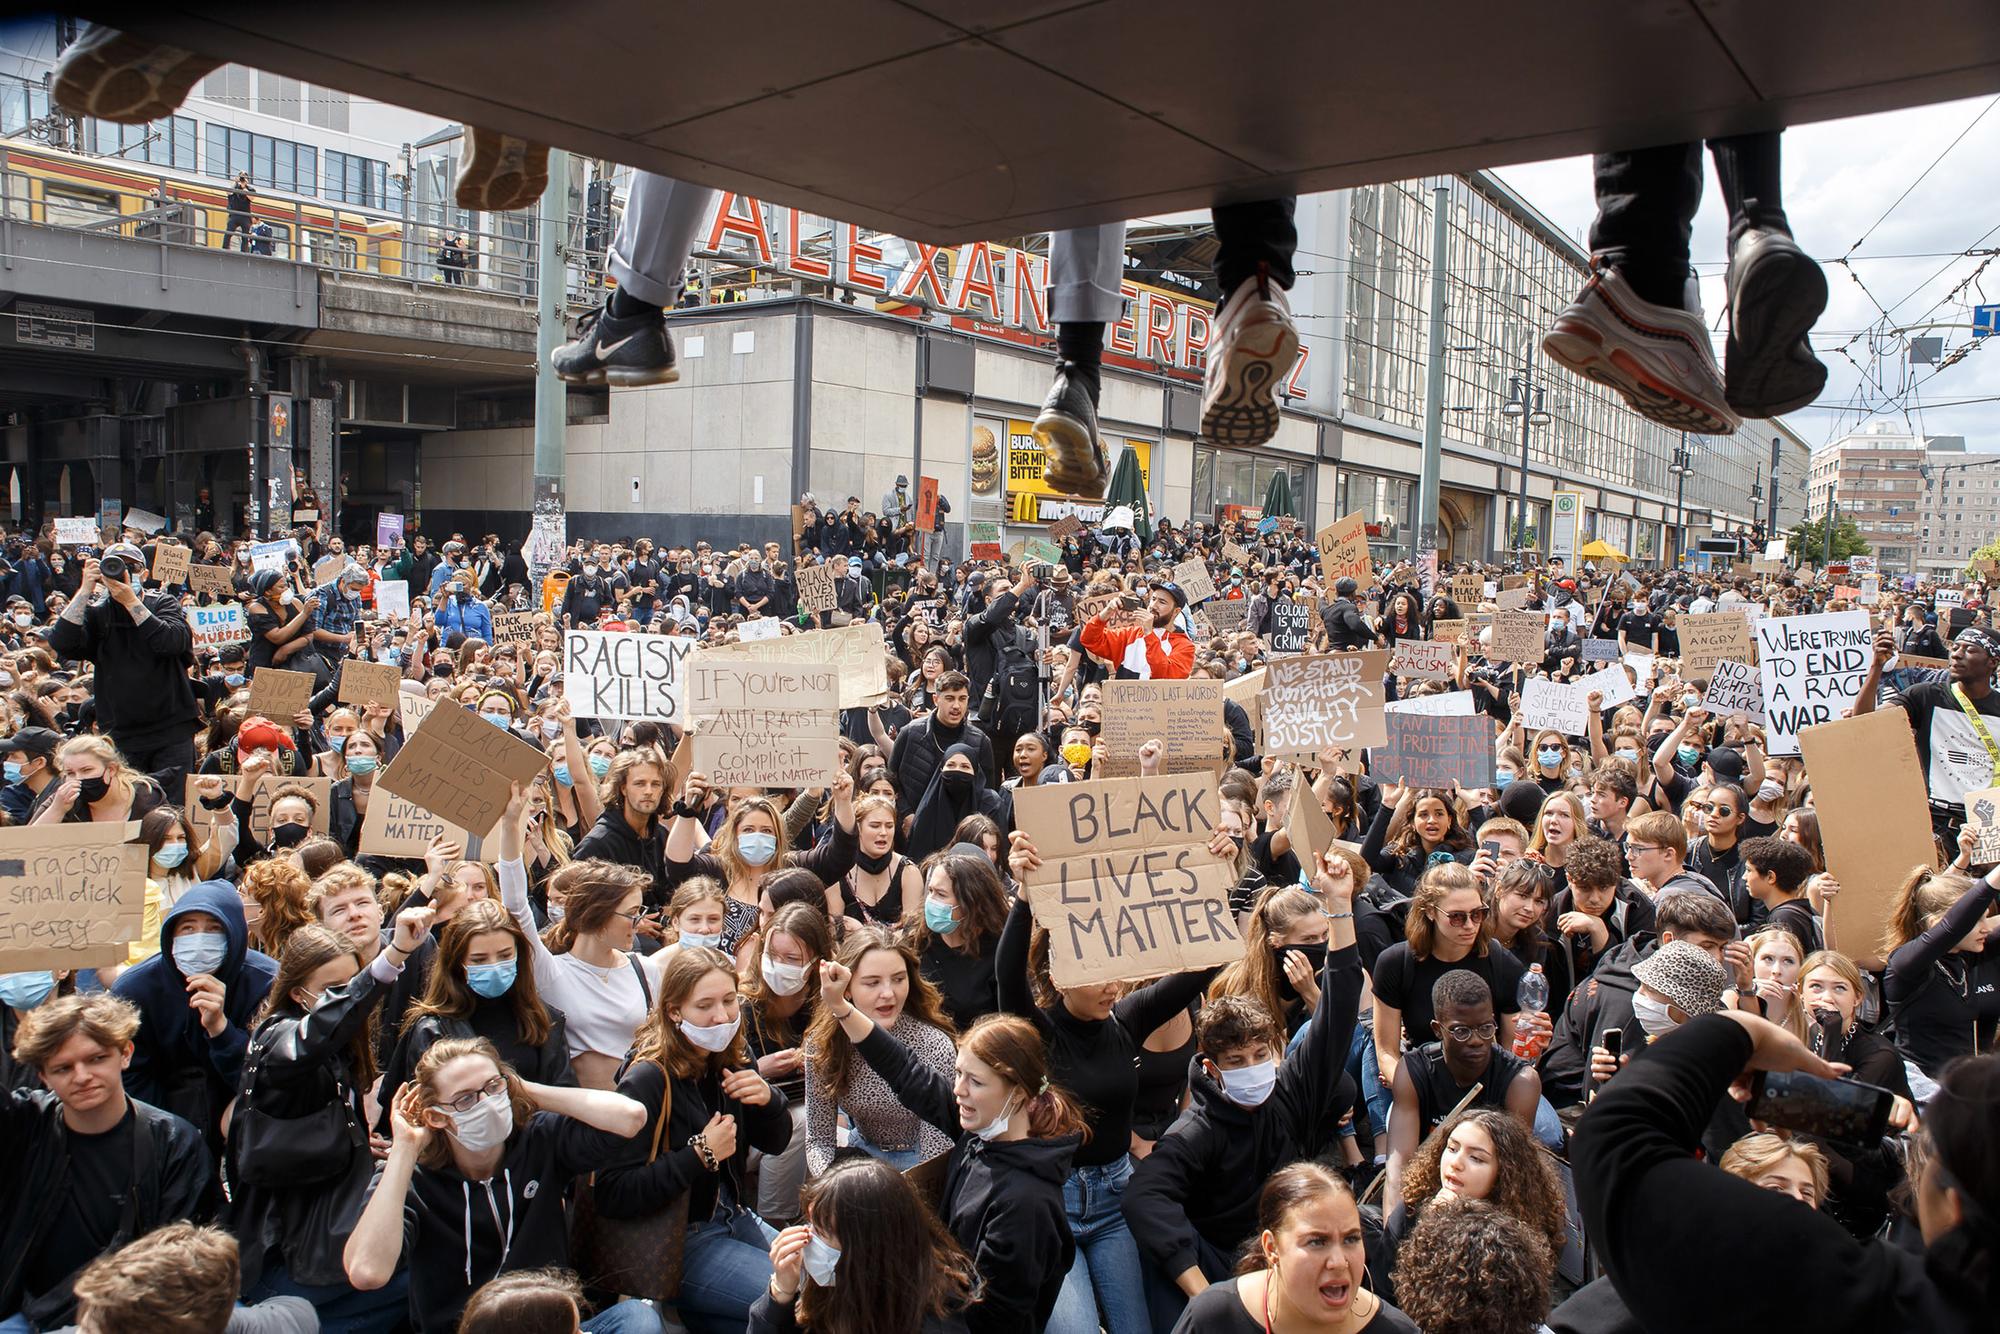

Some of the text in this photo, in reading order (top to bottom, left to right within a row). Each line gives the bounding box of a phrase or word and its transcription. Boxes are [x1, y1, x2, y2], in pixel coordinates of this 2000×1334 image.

[703, 190, 1310, 400] ALEXANERPZ
[1011, 434, 1043, 450] BURG
[1031, 452, 1046, 465] MIT
[1011, 466, 1041, 479] BITTE!
[1039, 500, 1105, 522] McDona
[1322, 533, 1340, 555] We
[163, 549, 184, 559] Black
[1333, 546, 1356, 566] stay
[159, 567, 187, 577] MATTER
[193, 567, 217, 579] Black
[800, 566, 830, 587] BLACK
[803, 583, 833, 598] LIVES
[1460, 578, 1474, 586] ALL
[1455, 588, 1481, 596] BLACK
[1457, 595, 1483, 603] LIVES
[803, 594, 836, 611] MATTER
[1274, 604, 1309, 616] COLOUR
[197, 609, 237, 625] BLUE
[495, 616, 522, 628] BLACK
[1279, 617, 1308, 628] IS NOT
[206, 624, 230, 632] LIVES
[508, 622, 534, 634] LIVES
[1286, 628, 1292, 636] A
[496, 631, 532, 644] MATTER
[1690, 634, 1737, 646] ANGRY
[1762, 624, 1822, 654] WE'RE
[1821, 629, 1872, 648] TRYING
[568, 635, 691, 683] RACISM
[1398, 642, 1442, 658] FIGHT
[1528, 648, 1541, 656] WE
[348, 662, 375, 674] BLACK
[1269, 658, 1364, 684] WE STAND
[1396, 656, 1448, 674] RACISM
[1718, 662, 1748, 680] NO
[1766, 649, 1865, 678] TO END
[252, 673, 304, 697] STOP
[346, 674, 372, 686] LIVES
[696, 668, 729, 700] IF
[802, 673, 837, 693] NOT
[1536, 682, 1578, 696] WHITE
[344, 684, 384, 697] MATTER
[593, 676, 676, 718] KILLS
[1162, 686, 1182, 701] LAST
[1186, 686, 1218, 700] WORDS
[1260, 675, 1373, 704] TOGETHER
[1772, 683, 1790, 702] A
[1532, 694, 1583, 714] SILENCE
[1706, 688, 1756, 712] BLACK
[1265, 696, 1360, 733] EQUALITY
[1527, 714, 1579, 732] VIOLENCE
[1769, 704, 1832, 736] WAR
[1392, 716, 1489, 734] CAN'T BELIEVE
[448, 716, 519, 763] BLACK
[1403, 734, 1496, 755] PROTESTING
[430, 746, 491, 786] LIVES
[1406, 757, 1438, 779] THIS
[1441, 758, 1478, 783] SHIT
[396, 763, 494, 825] MATTER
[388, 804, 433, 820] LIVES
[1069, 788, 1213, 844] BLACK
[33, 850, 120, 876] racism
[1060, 850, 1198, 904] LIVES
[9, 876, 122, 905] small dick
[1068, 898, 1236, 960] MATTER
